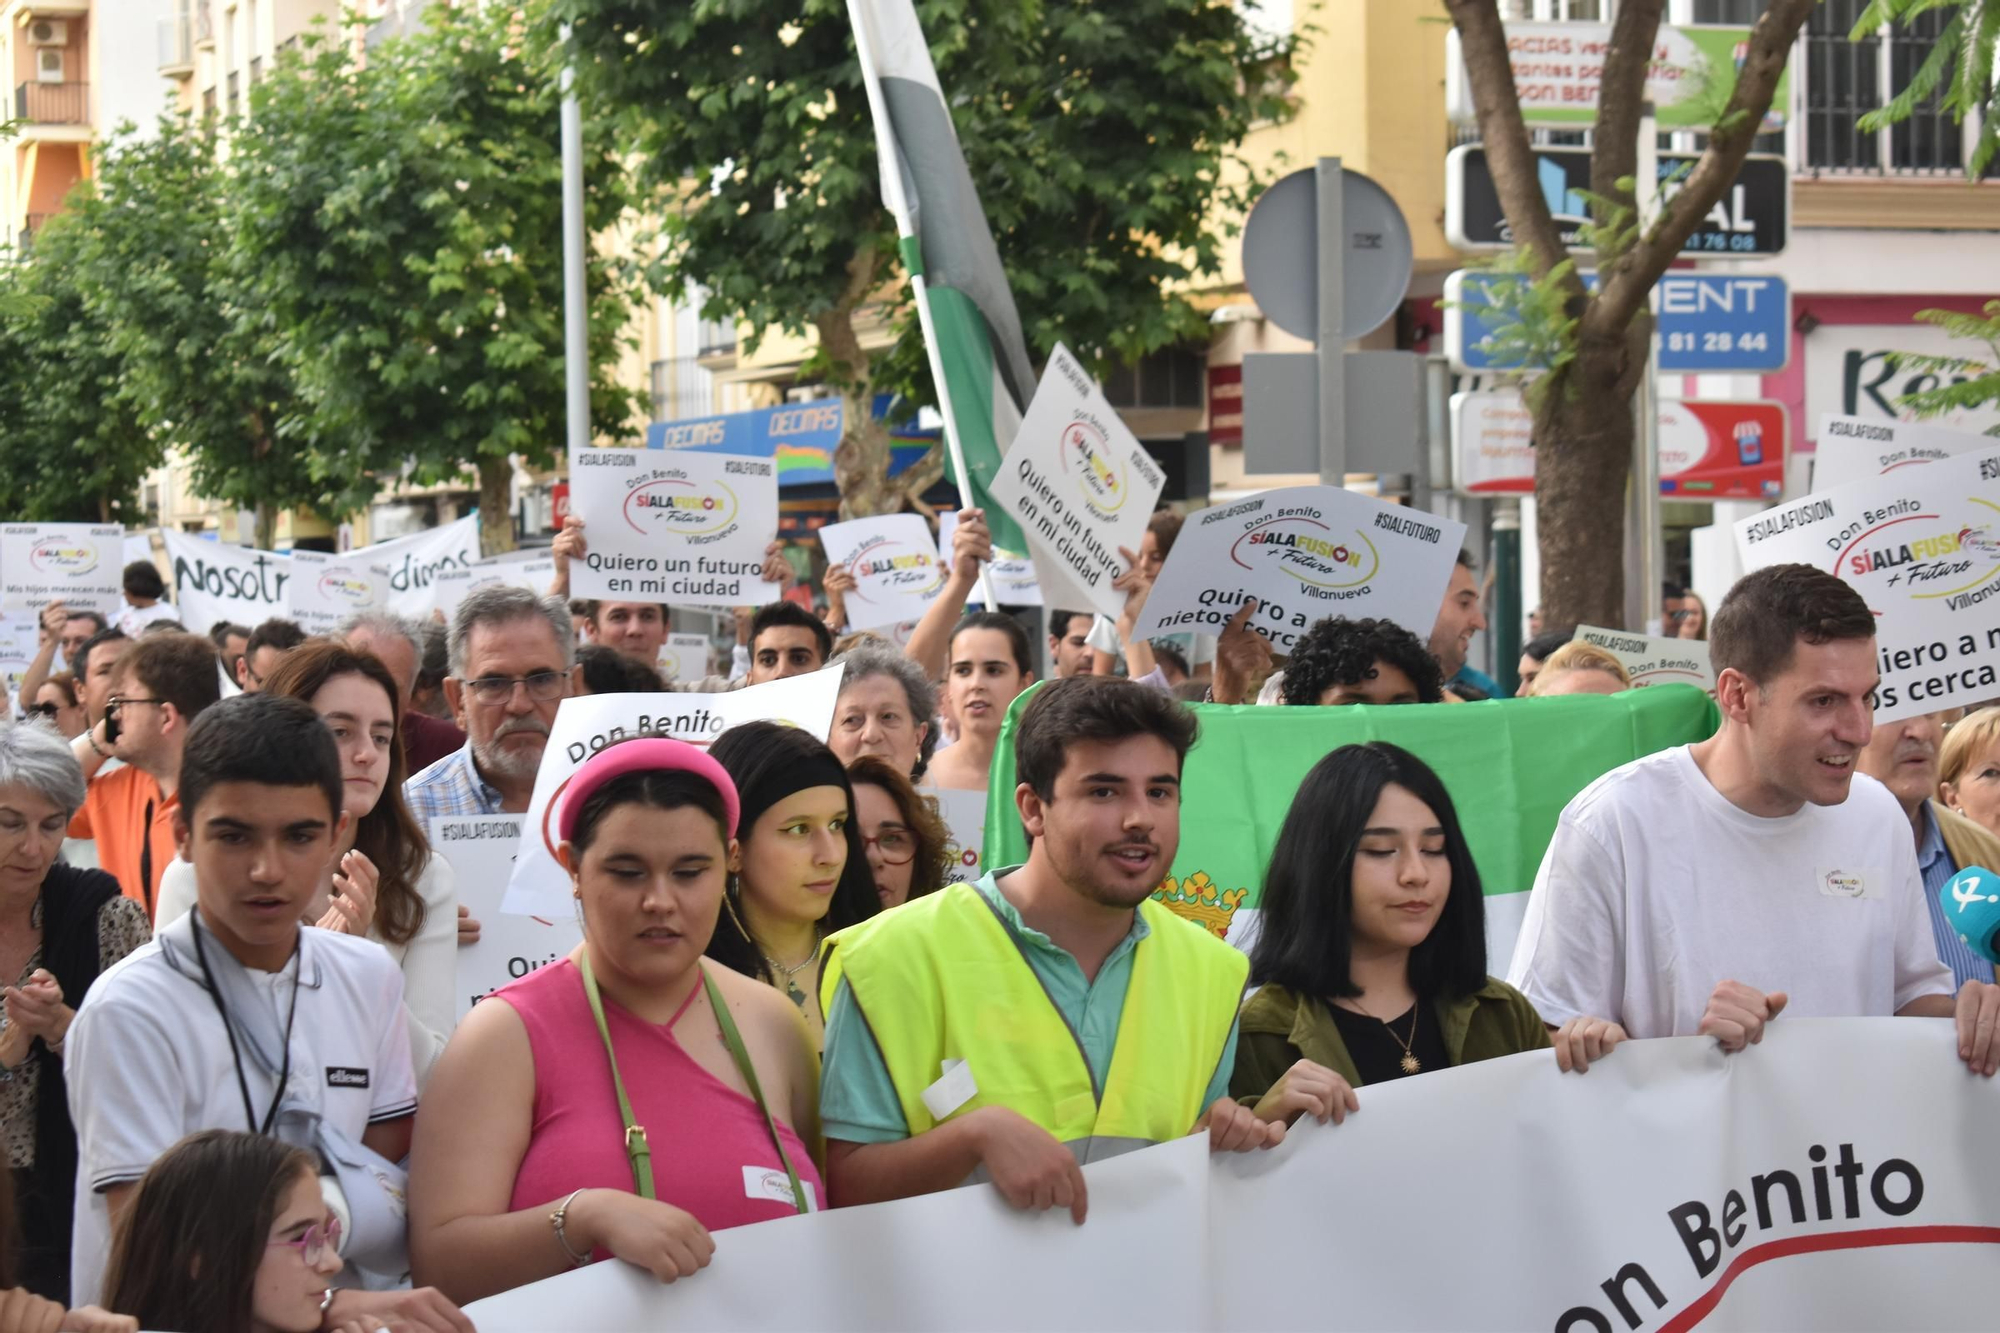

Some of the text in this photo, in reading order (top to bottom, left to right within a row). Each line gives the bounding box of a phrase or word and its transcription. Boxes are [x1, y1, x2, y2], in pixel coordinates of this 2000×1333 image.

[1508, 36, 1572, 54] ACIAS
[1704, 233, 1727, 249] 76
[1669, 332, 1767, 351] 81 28 44
[769, 405, 840, 437] DECIMAS
[1829, 421, 1894, 441] #SIALAFUSION
[664, 420, 726, 450] DECIMAS
[1880, 451, 1906, 466] Don
[626, 469, 688, 488] Don Benito
[667, 510, 708, 522] Futuro
[1017, 458, 1121, 580] Quiero un futuro
[1244, 506, 1321, 531] Don Benito
[1374, 512, 1441, 544] #SIALFUTURO
[1747, 498, 1835, 544] #SIALAFUSION
[1826, 499, 1921, 551] Don Benito
[685, 523, 738, 545] Villanueva
[1018, 495, 1101, 588] en mi ciudad
[587, 553, 763, 576] Quiero un futuro
[1281, 548, 1336, 574] Futuro
[1907, 559, 1973, 585] Futuro
[175, 555, 290, 604] Nosotr
[608, 576, 740, 596] en mi ciudad
[1300, 582, 1371, 601] Villanueva
[1945, 578, 2000, 611] Villanu
[1291, 613, 1308, 628] a
[1241, 621, 1302, 647] cerc
[1628, 658, 1699, 675] Don Benito
[1876, 641, 1948, 675] iero
[1958, 634, 1977, 656] a
[1907, 664, 1997, 702] cerca
[566, 709, 725, 764] Don Benito
[442, 821, 521, 841] #SIALAFUSION
[1667, 1143, 1925, 1279] Benito
